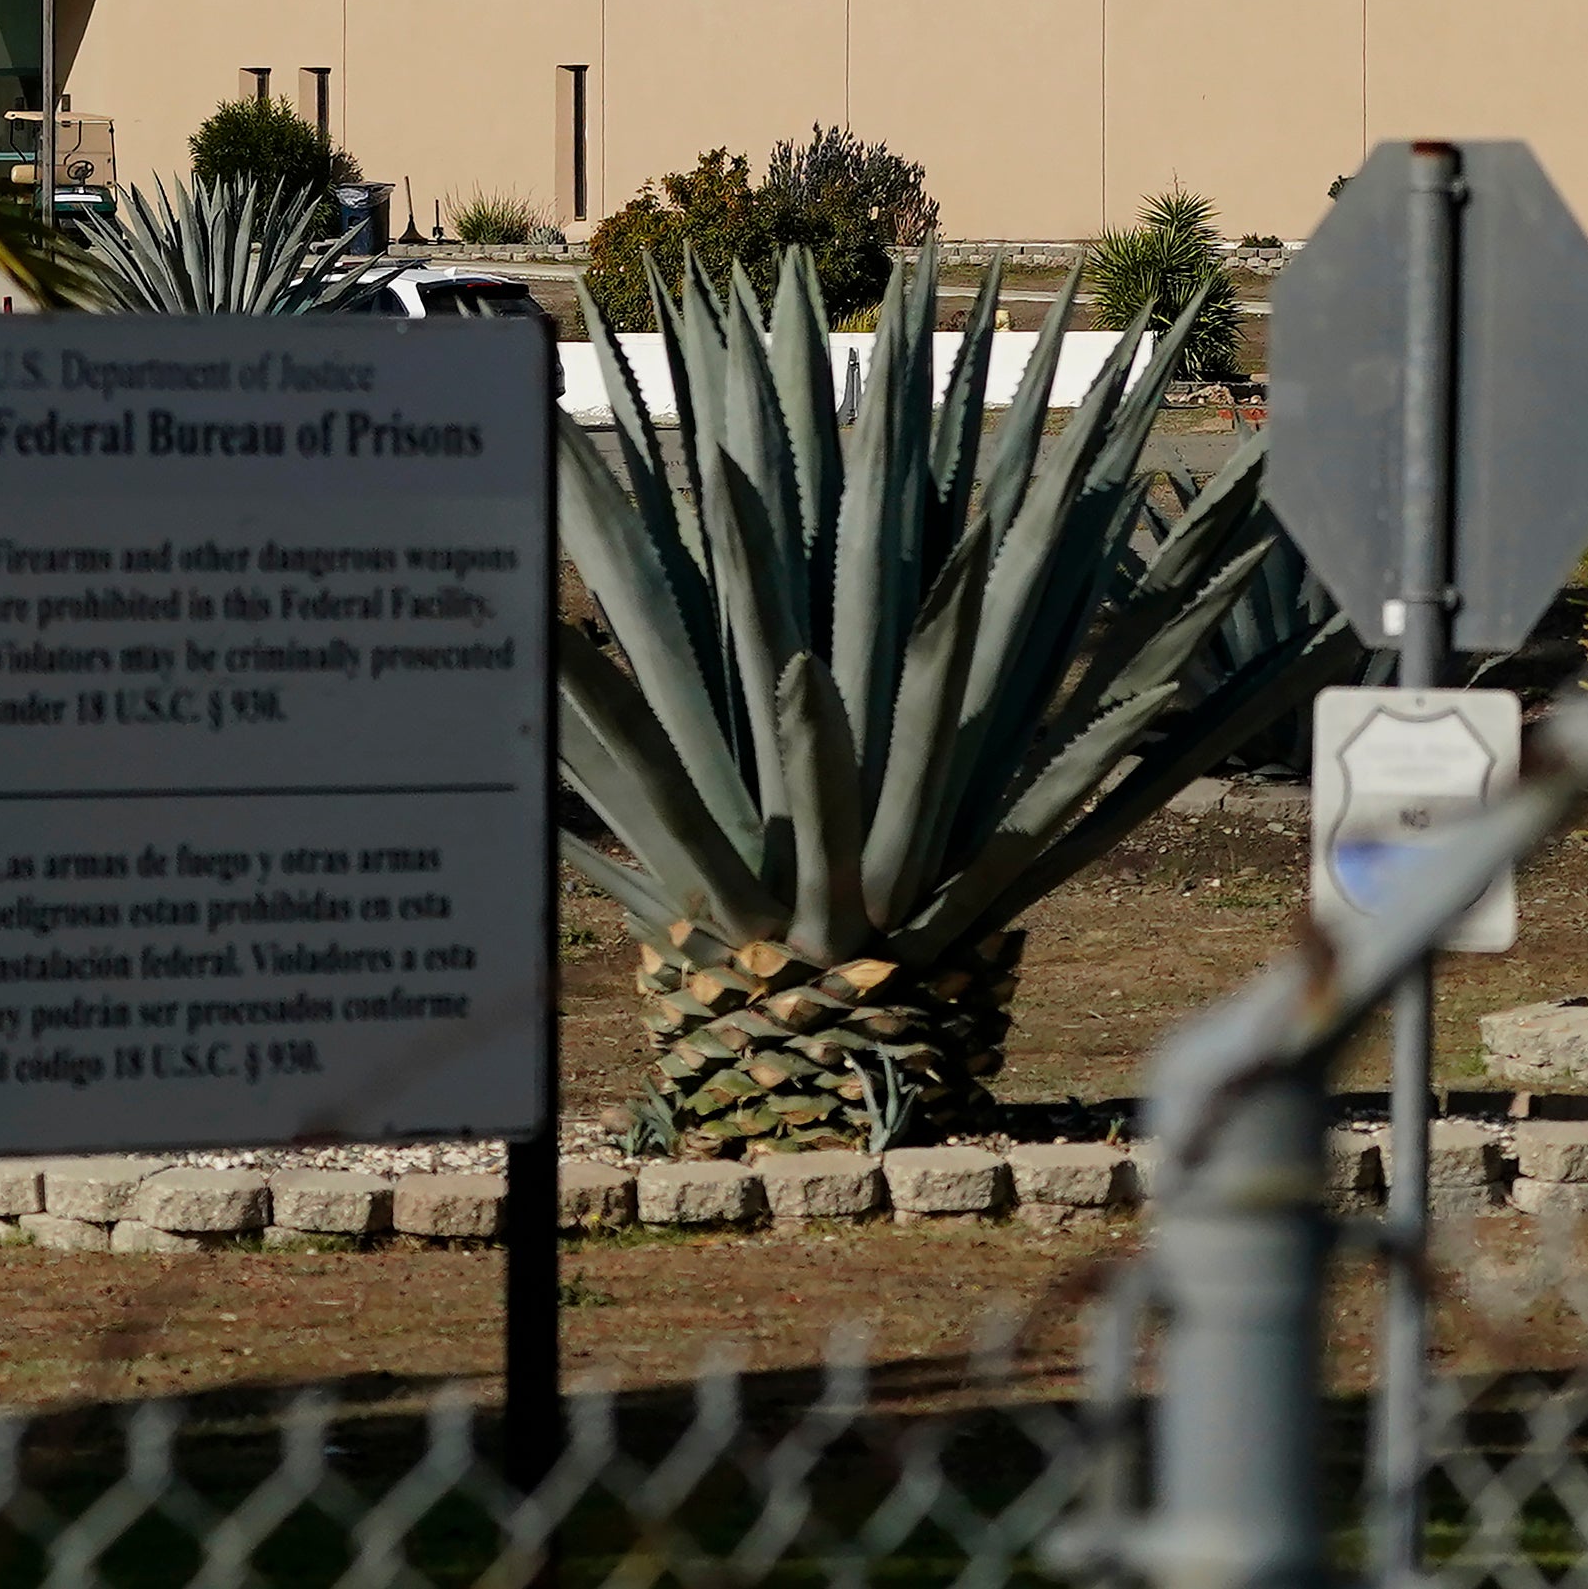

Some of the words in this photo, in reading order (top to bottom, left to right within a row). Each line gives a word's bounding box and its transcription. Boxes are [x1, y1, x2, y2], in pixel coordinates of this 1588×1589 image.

[60, 351, 232, 402] Department
[238, 352, 272, 392] of
[278, 352, 376, 393] Justice
[147, 409, 286, 457] Bureau
[296, 409, 338, 457] of
[346, 409, 484, 458] Prisons
[120, 538, 173, 573] and
[178, 538, 252, 573] other
[257, 537, 398, 582] dangerous
[403, 546, 519, 581] weapons
[36, 590, 182, 632] prohibited
[188, 590, 217, 622] in
[222, 589, 273, 622] this
[279, 589, 384, 621] Federal
[119, 647, 176, 683] may
[185, 639, 220, 672] be
[224, 638, 361, 682] criminally
[370, 637, 516, 681] prosecuted
[76, 689, 108, 725] 18
[42, 852, 130, 881] armas
[135, 843, 170, 879] de
[175, 842, 252, 888] fuego
[256, 850, 273, 887] y
[280, 844, 352, 876] otras
[357, 846, 442, 875] armas
[207, 891, 355, 935] prohibidas
[359, 898, 393, 924] en
[397, 893, 452, 923] esta
[251, 942, 395, 979] Violadores
[400, 948, 418, 976] a
[423, 943, 477, 975] esta
[138, 1004, 181, 1031] ser
[186, 993, 336, 1038] procesados
[341, 990, 470, 1027] conforme
[114, 1047, 146, 1082] 18
